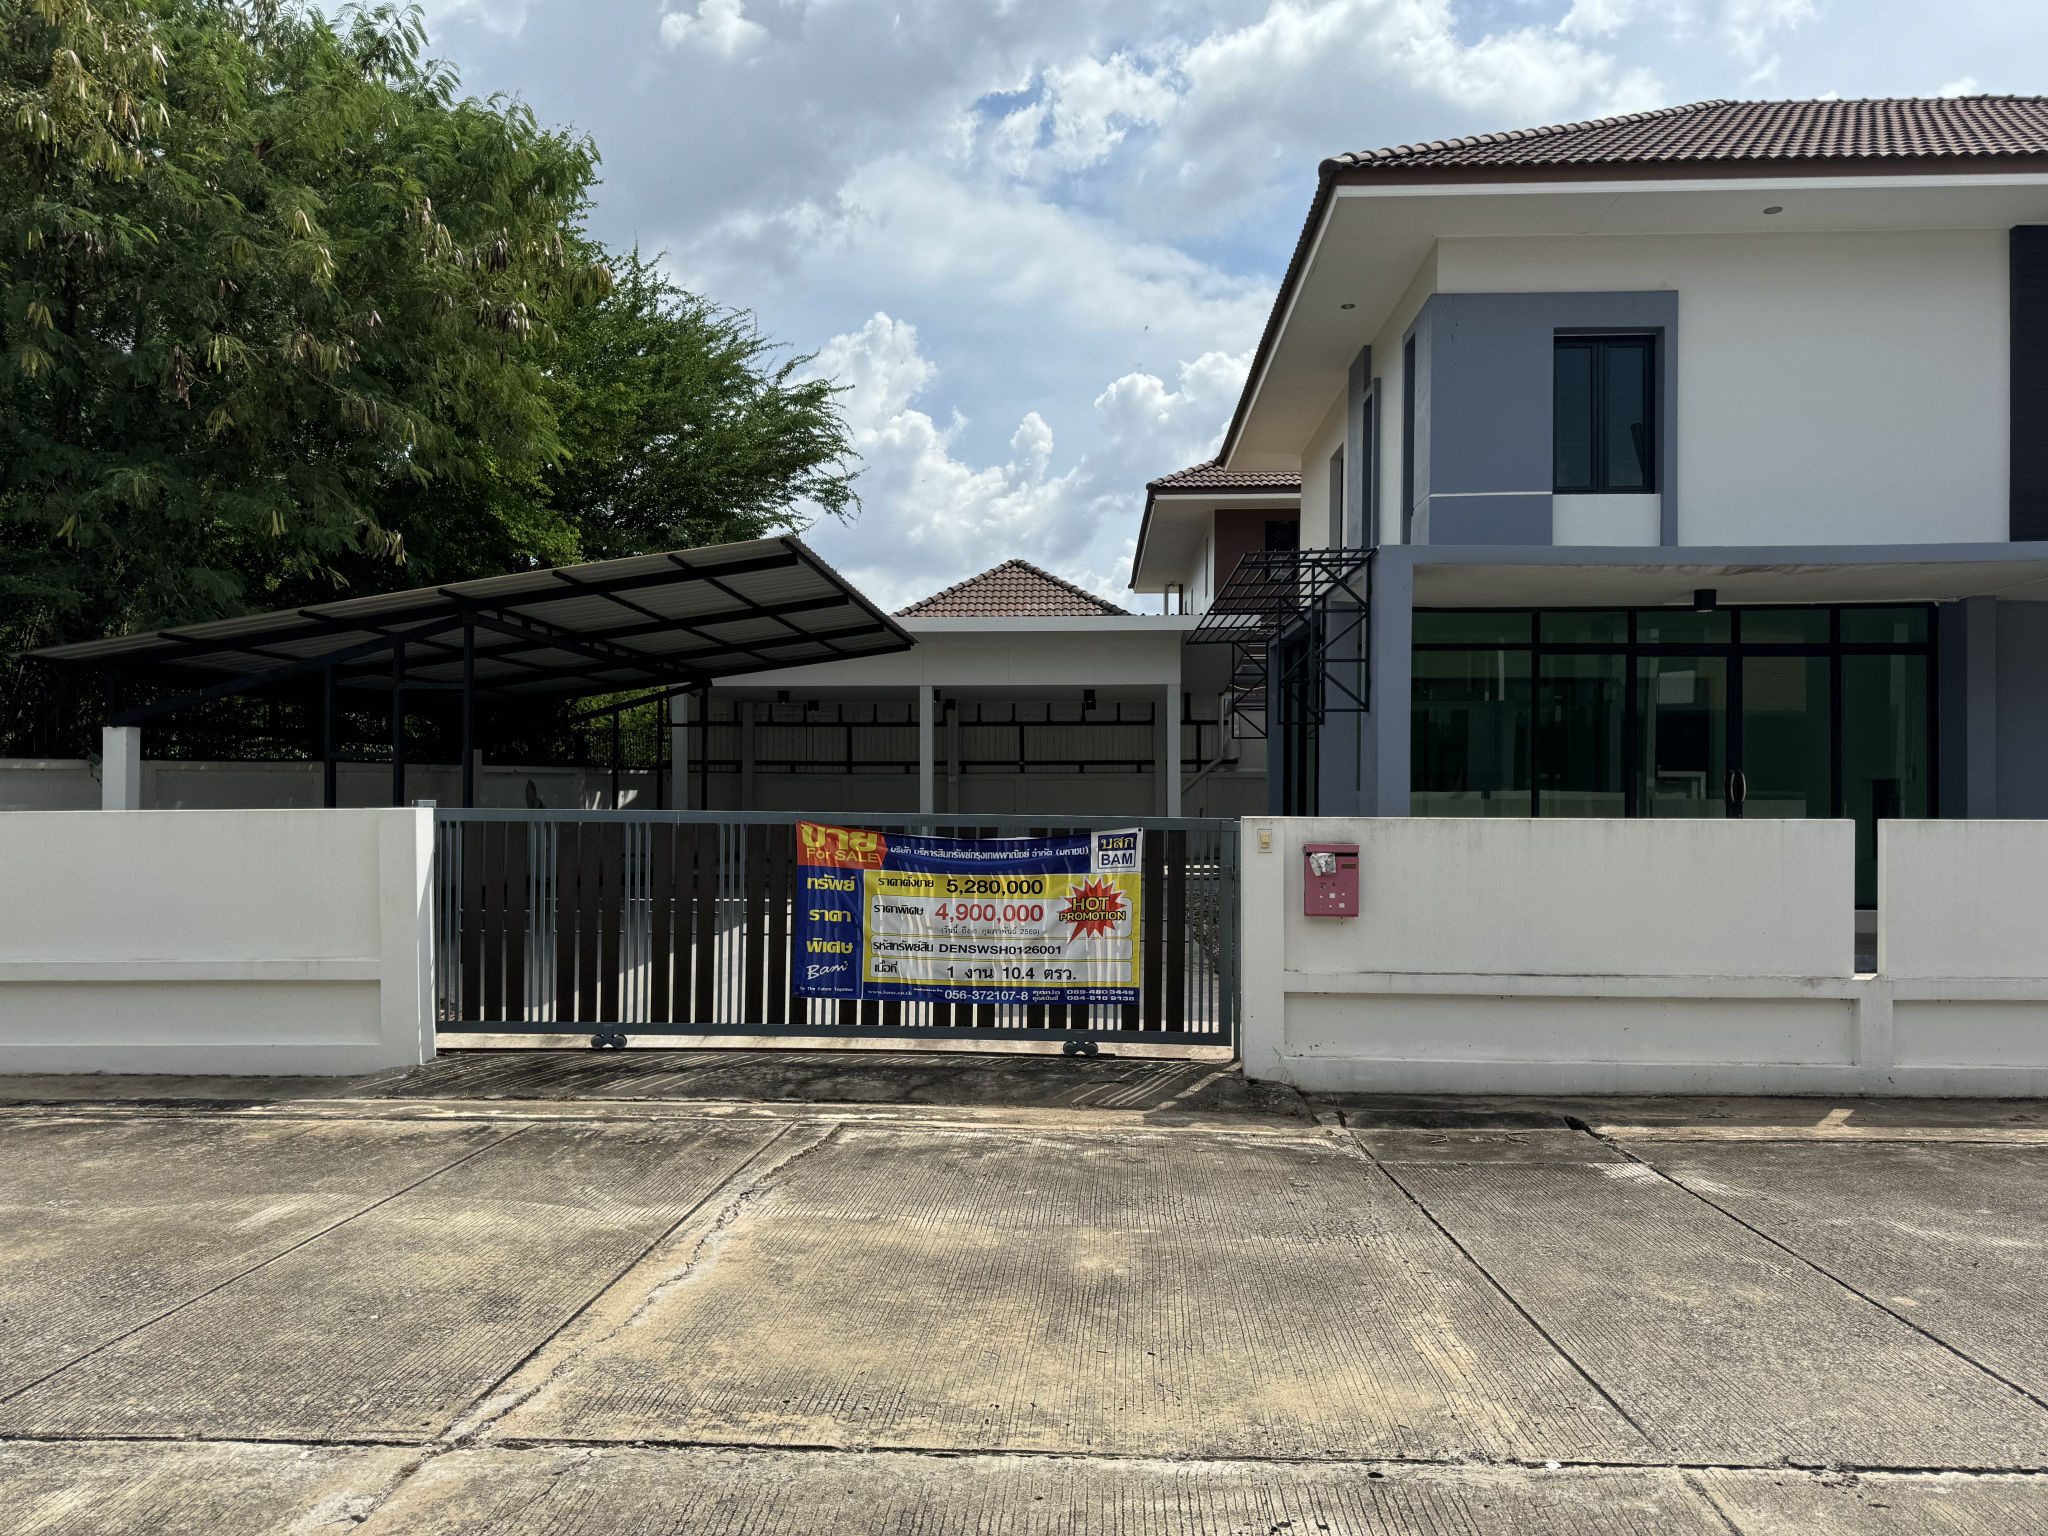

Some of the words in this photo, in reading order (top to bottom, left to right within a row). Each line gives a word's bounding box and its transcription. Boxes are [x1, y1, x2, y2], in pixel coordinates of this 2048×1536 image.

[801, 824, 878, 852] ขาย
[1101, 837, 1134, 850] บสก
[806, 847, 831, 859] For
[835, 850, 879, 863] SALE
[890, 845, 912, 854] บริษัท
[1031, 847, 1053, 858] จำกัด
[1055, 846, 1089, 856] (มหาชน)
[1101, 852, 1133, 866] BAM
[807, 874, 856, 891] ทรัพย์
[946, 879, 1044, 896] 5,280,000
[1072, 896, 1110, 911] HOT
[809, 909, 852, 923] ราคา
[874, 903, 924, 916] ราคาพิเศษ
[934, 903, 1044, 923] 4,900,000
[1059, 911, 1126, 921] PROMOTION
[806, 937, 854, 954] พิเศษ
[938, 943, 1062, 955] DENSWSH0126001
[947, 966, 955, 979] 1
[964, 966, 994, 980] งาน
[1002, 966, 1035, 980] 10.4
[1043, 967, 1077, 981] ตรว.
[944, 990, 1029, 1001] 056-372107-8
